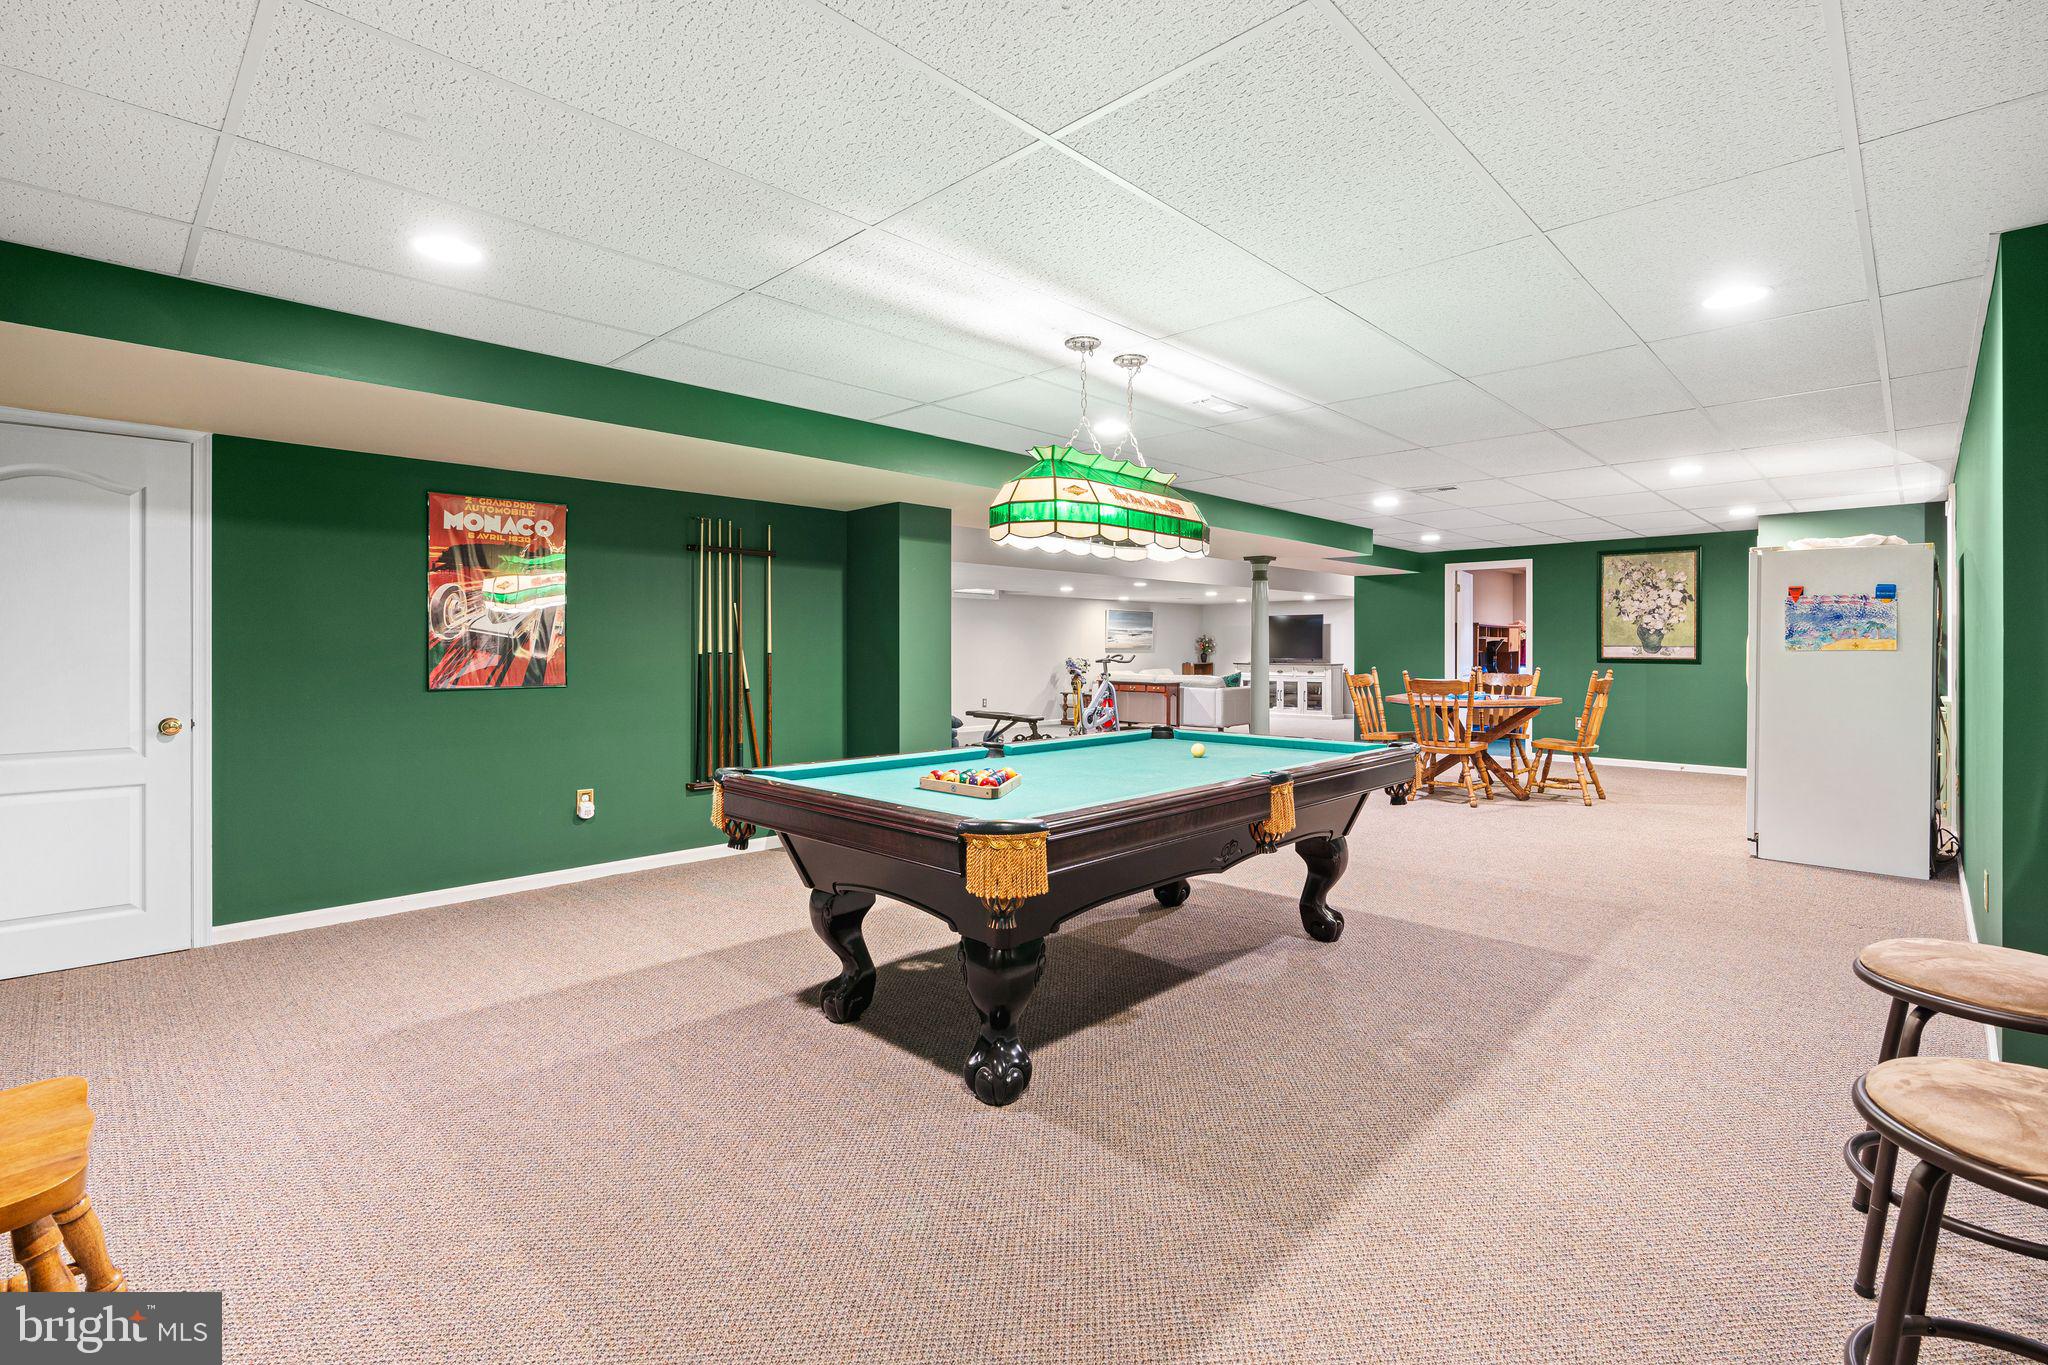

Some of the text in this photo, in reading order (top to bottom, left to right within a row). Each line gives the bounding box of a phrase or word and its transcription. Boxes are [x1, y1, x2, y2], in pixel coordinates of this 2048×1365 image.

[464, 503, 536, 518] AUTOMOBILE
[479, 497, 513, 508] GRAND
[513, 501, 536, 511] PRIX
[443, 509, 555, 538] MONACO
[477, 533, 506, 541] AVRIL
